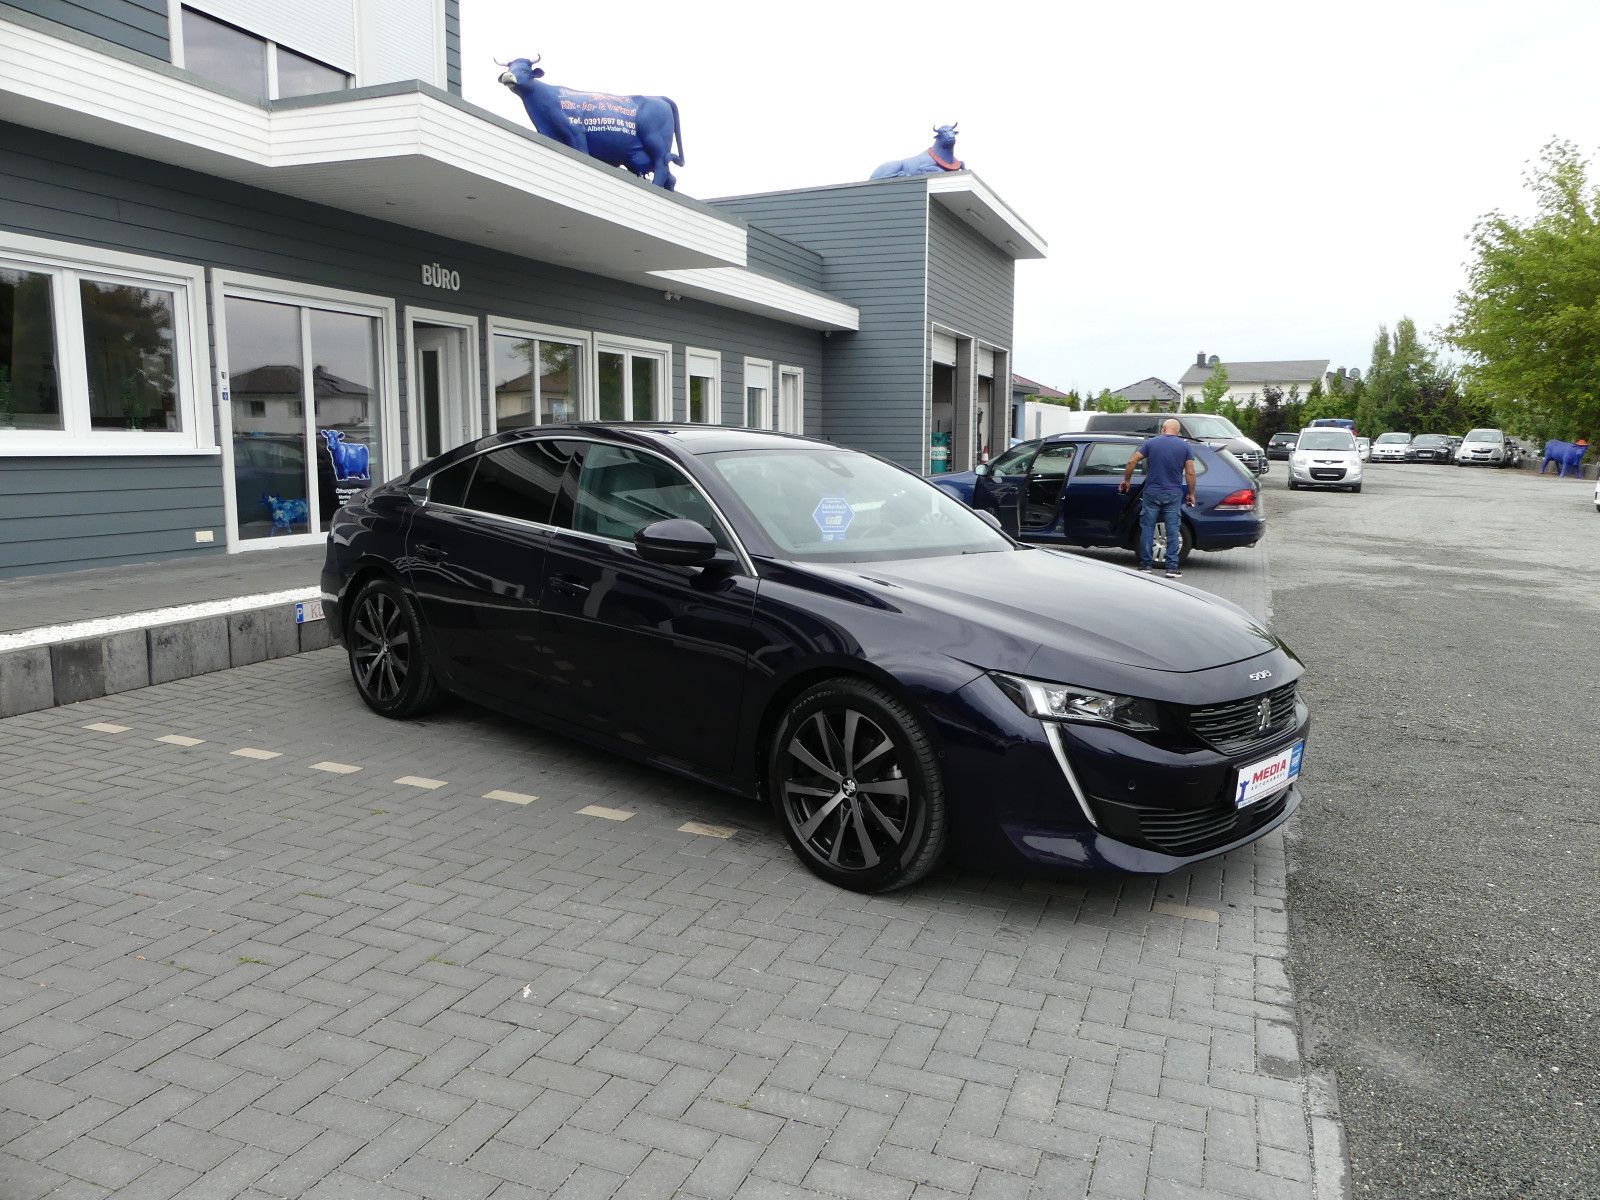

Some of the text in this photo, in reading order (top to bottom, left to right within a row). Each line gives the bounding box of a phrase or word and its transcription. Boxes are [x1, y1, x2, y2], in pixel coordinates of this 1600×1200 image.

[568, 117, 583, 125] Tel.
[421, 262, 460, 290] BÜRO
[1249, 669, 1272, 681] 508
[1251, 758, 1287, 784] MEDIA
